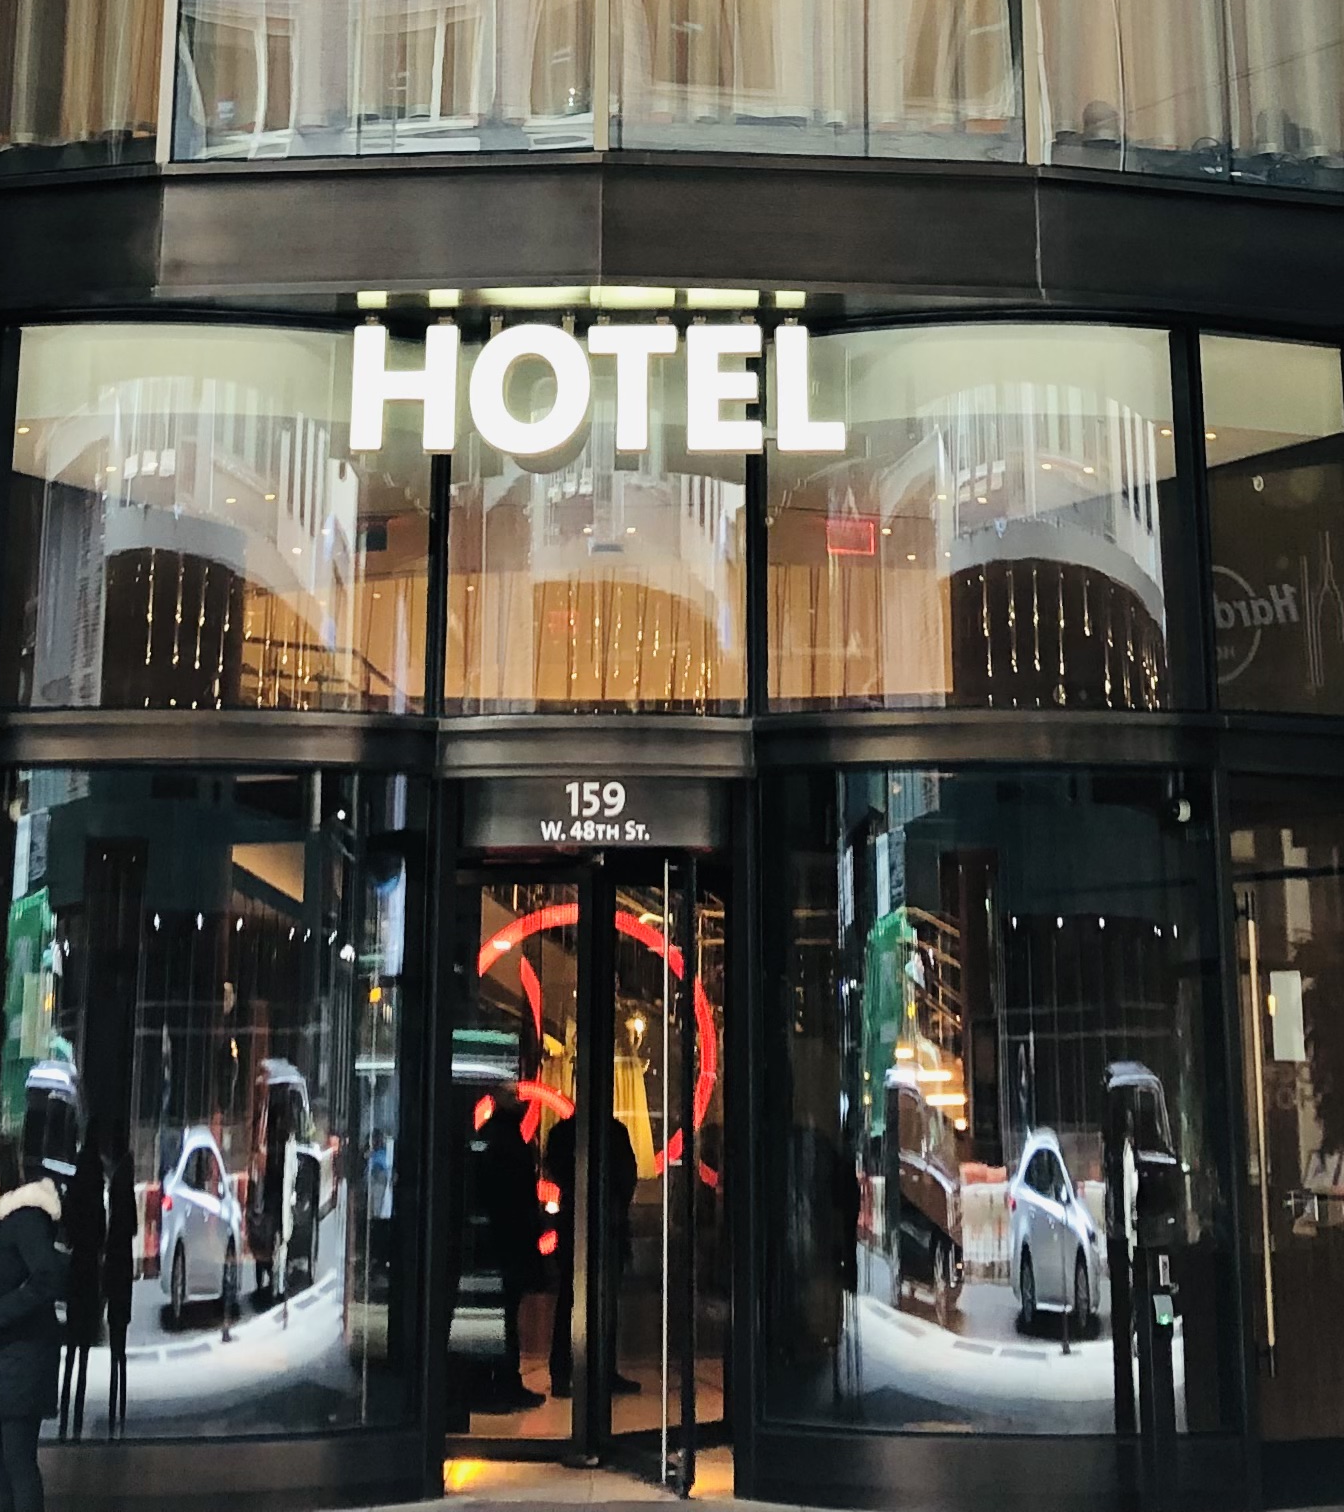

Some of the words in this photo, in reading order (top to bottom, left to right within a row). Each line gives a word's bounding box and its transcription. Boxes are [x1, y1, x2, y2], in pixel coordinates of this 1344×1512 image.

[350, 323, 846, 455] HOTEL
[565, 781, 626, 817] 159
[540, 820, 567, 841] W.
